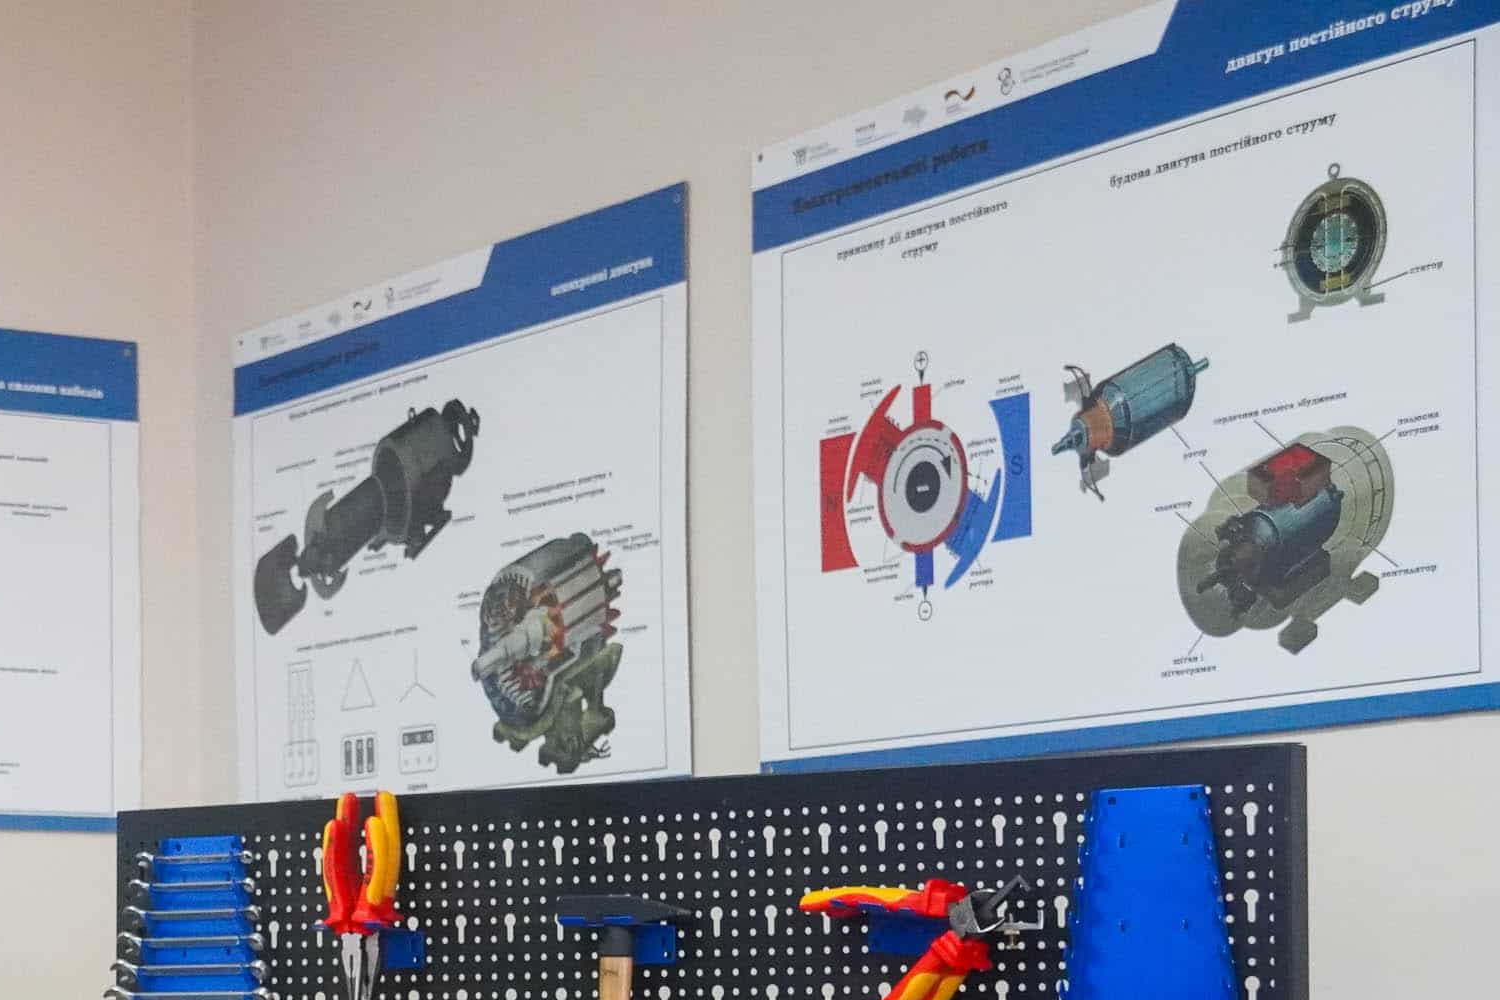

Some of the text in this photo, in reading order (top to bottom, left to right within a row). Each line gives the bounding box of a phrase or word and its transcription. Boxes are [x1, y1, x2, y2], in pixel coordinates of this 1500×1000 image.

[1225, 43, 1284, 73] двигун
[1289, 12, 1386, 52] постійного
[1109, 113, 1336, 188] будова двигуна постійного струму
[949, 200, 1008, 225] постійного
[901, 241, 939, 259] струму
